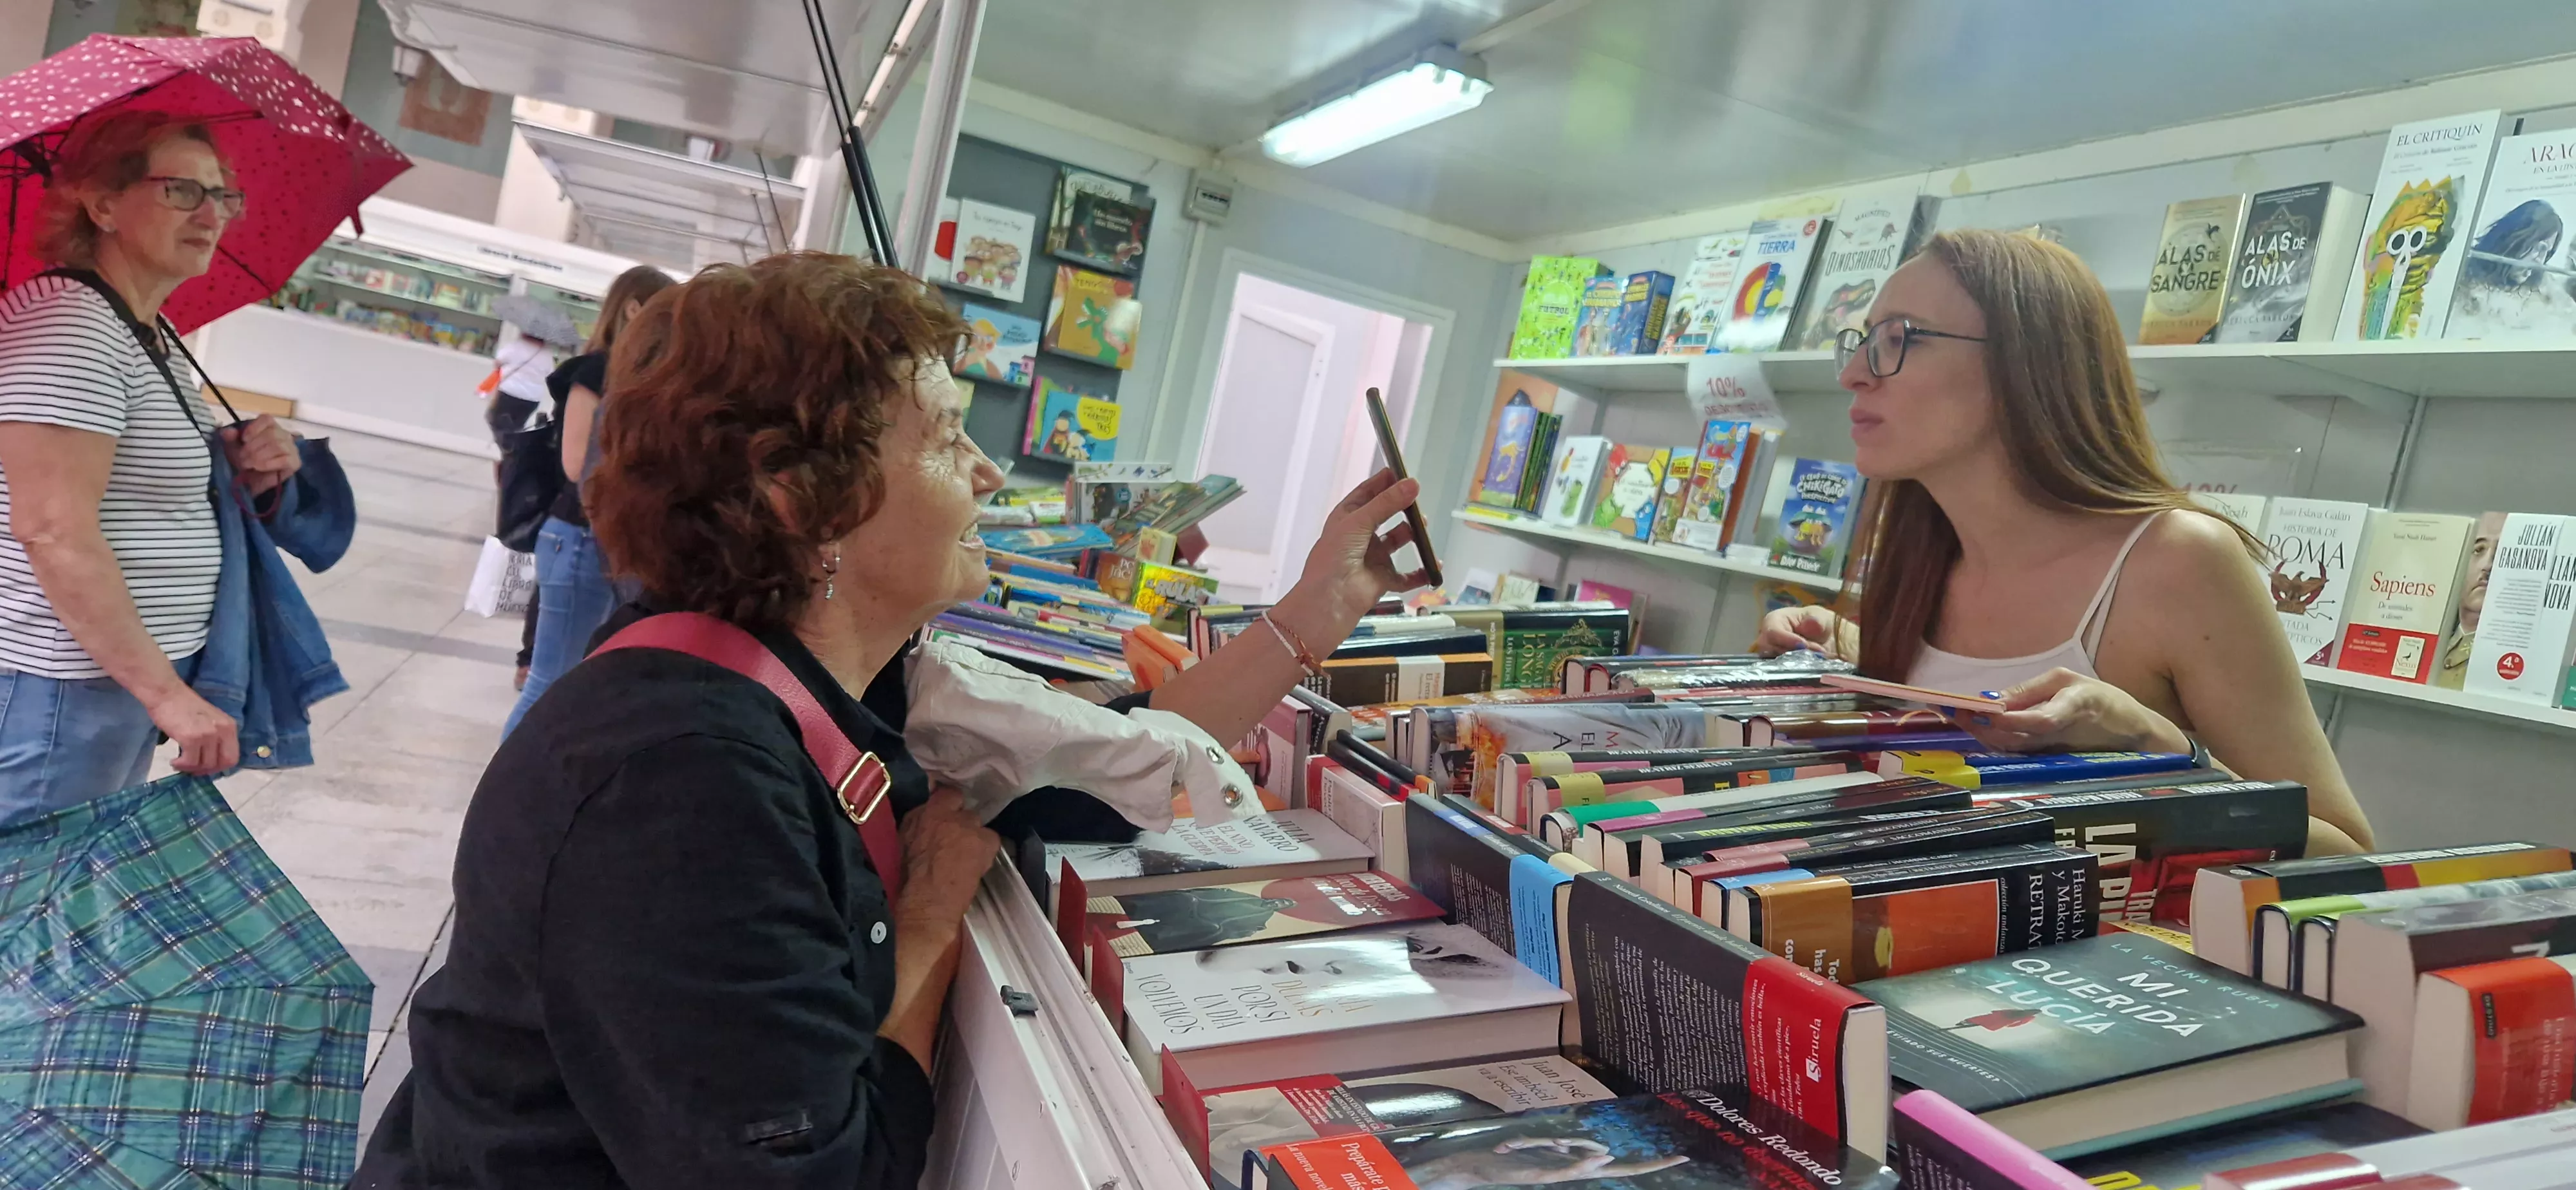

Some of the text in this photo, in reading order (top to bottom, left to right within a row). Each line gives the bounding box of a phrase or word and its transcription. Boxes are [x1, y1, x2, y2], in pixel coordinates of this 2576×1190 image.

[2396, 122, 2483, 147] EL CRITIQUÍN
[1757, 240, 1796, 255] TIERRA
[2157, 244, 2221, 266] ALAS DE
[2244, 231, 2307, 256] ALAS DE
[1824, 245, 1895, 276] DINOSAURIOS
[2241, 258, 2296, 288] ÓNIX
[2150, 270, 2221, 294] SANGRE
[1707, 377, 1745, 397] 10%
[1797, 480, 1845, 498] CHIKIGATO
[2298, 507, 2323, 520] Eslava
[2324, 509, 2352, 522] Galán
[2283, 524, 2339, 538] HISTORIA DE
[2517, 522, 2556, 547] JULIÁN
[2265, 534, 2345, 569] ROMA
[2498, 547, 2548, 571] CASANOVA
[2550, 554, 2576, 582] LIÁN
[2371, 572, 2436, 600] Sapiens
[2544, 582, 2571, 610] NOVA
[2378, 601, 2387, 610] De
[1535, 634, 1546, 681] LA SAGA
[1424, 682, 1432, 699] retra
[1684, 762, 1732, 770] SERRANO
[1171, 824, 1215, 856] LA GUERRA
[1204, 833, 1242, 856] PERDIÓ
[1217, 825, 1256, 849] EL NIÑO
[1242, 815, 1300, 853] NAVARRO
[1271, 819, 1315, 844] JULIA
[1890, 827, 1962, 840] SACCOMANNO
[2085, 823, 2136, 867] LA
[2052, 870, 2067, 881] y
[1356, 895, 1382, 908] Dios
[2072, 867, 2087, 925] Haruki
[1999, 877, 2008, 954] colección andanzas
[1814, 949, 1826, 974] has
[1828, 958, 1840, 983] Tod
[2110, 943, 2280, 1010] LA VECINA RUBIA
[2117, 972, 2189, 997] MI
[1134, 973, 1204, 1035] VOLVEMOS
[1193, 993, 1248, 1030] UN DÍA
[1231, 985, 1291, 1023] POR SI
[1749, 979, 1759, 1023] emociones
[1985, 979, 2116, 1035] LUCÍA
[2011, 958, 2204, 1037] QUERIDA
[1806, 1018, 1822, 1083] Siruela
[1927, 1047, 1947, 1060] SUS
[1947, 1056, 2001, 1083] MUERTES?
[1477, 1068, 1492, 1076] va
[1493, 1079, 1531, 1105] escribir
[1499, 1064, 1558, 1101] Ese imbécil
[1521, 1061, 1593, 1099] Juan José
[1685, 1110, 1721, 1130] que
[1718, 1131, 1745, 1146] no
[1696, 1094, 1763, 1135] Dolores
[1758, 1134, 1842, 1186] Redondo
[1286, 1143, 1332, 1190] La nueva novel
[1341, 1142, 1385, 1185] Prepárate
